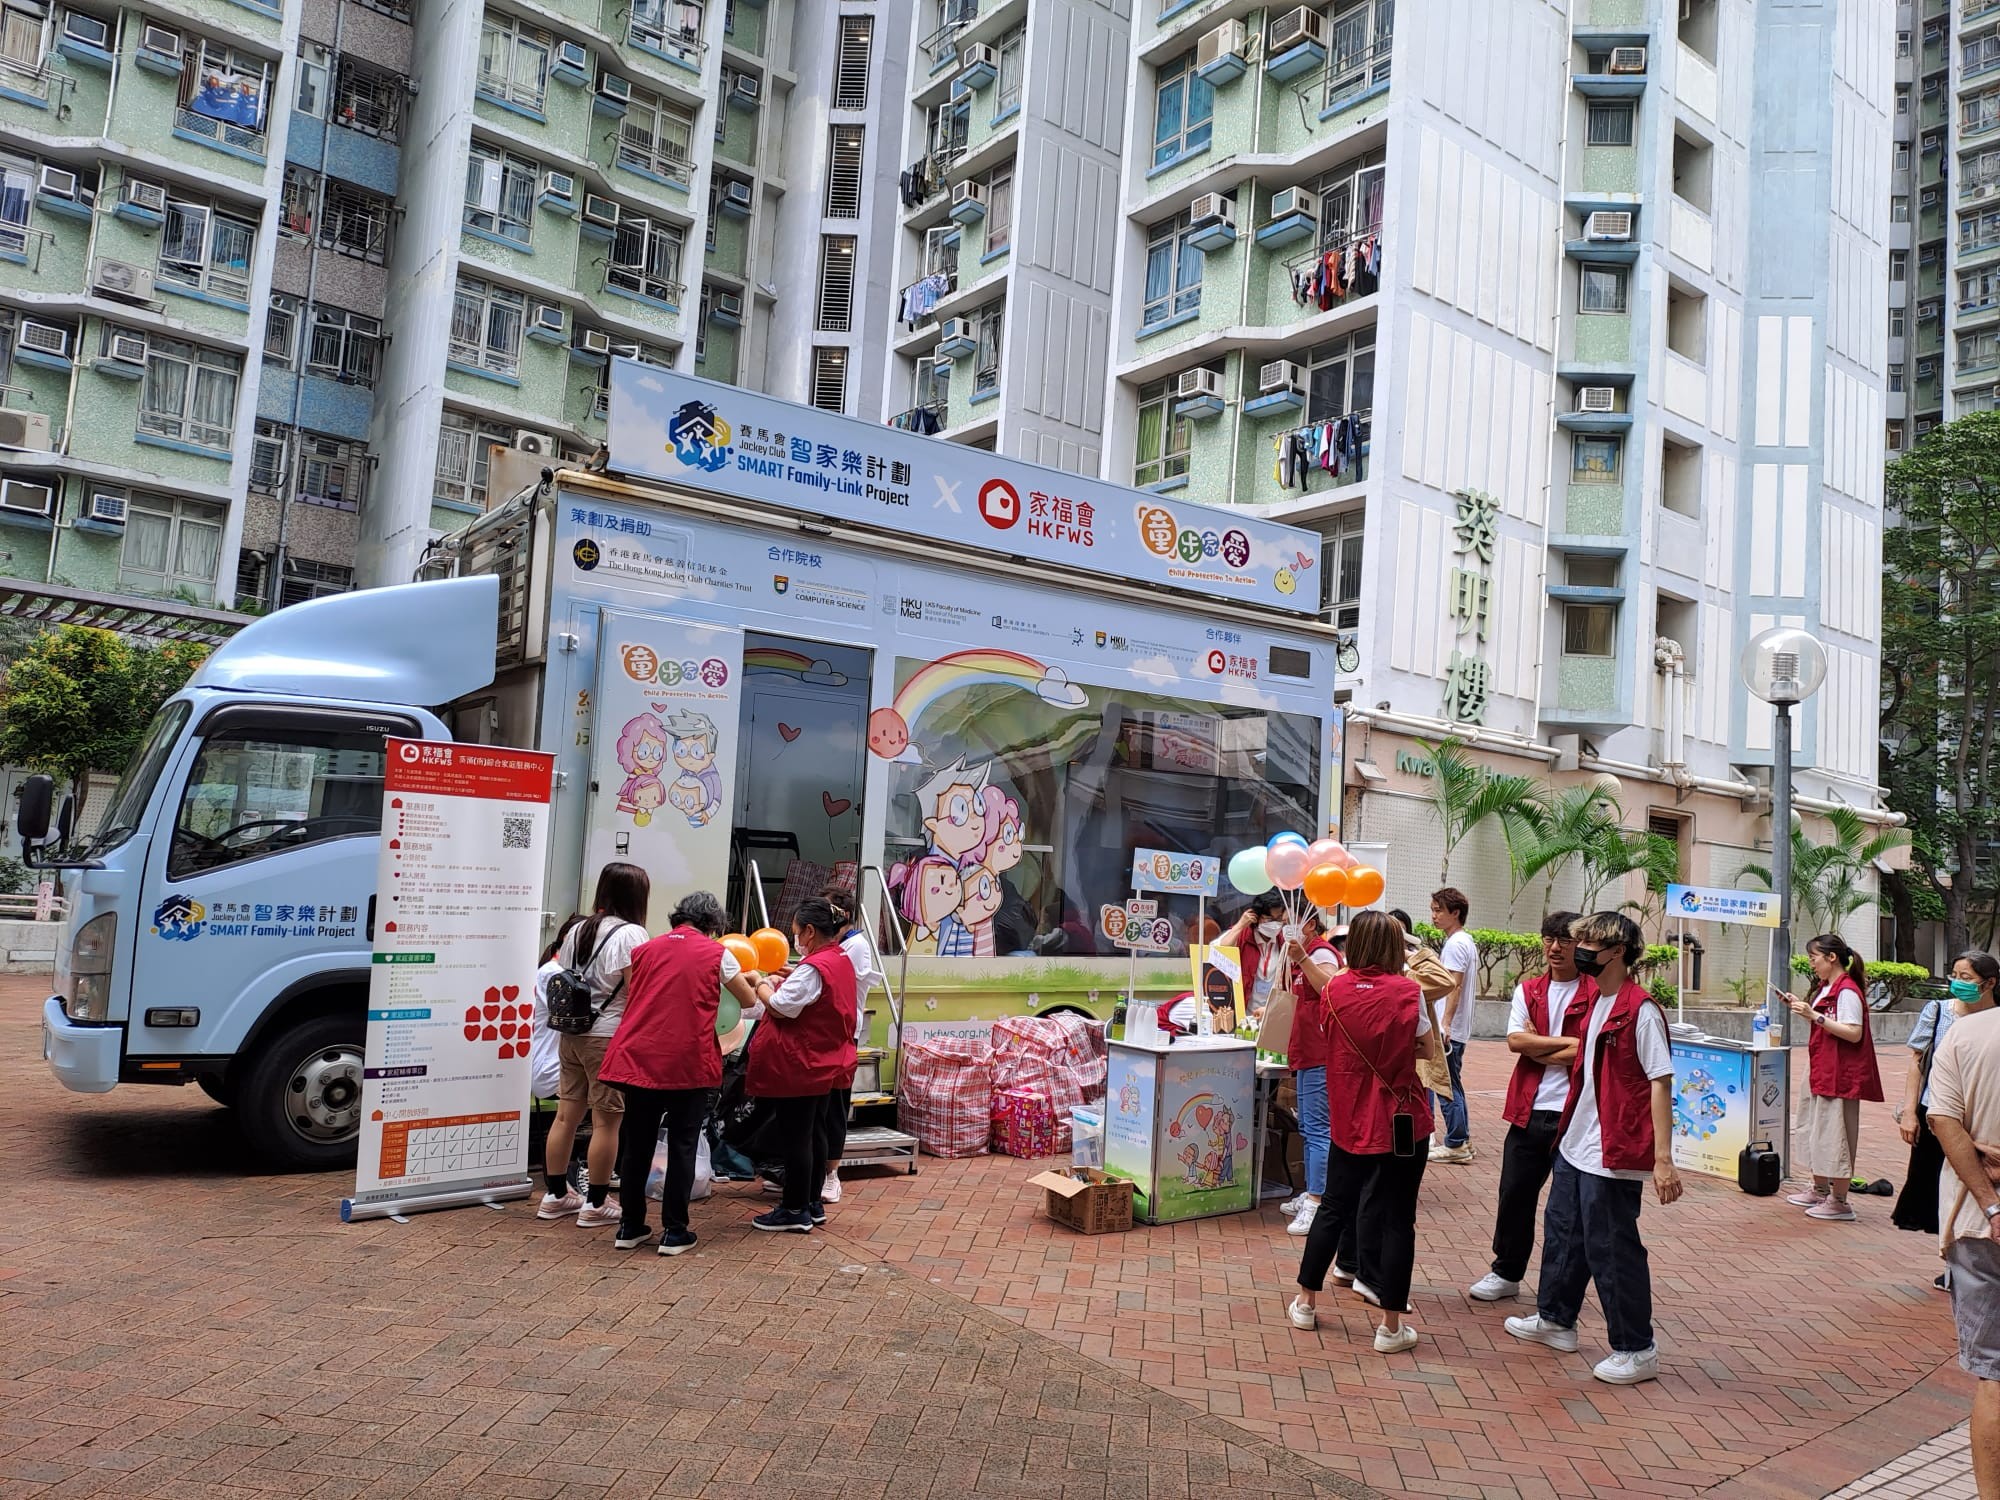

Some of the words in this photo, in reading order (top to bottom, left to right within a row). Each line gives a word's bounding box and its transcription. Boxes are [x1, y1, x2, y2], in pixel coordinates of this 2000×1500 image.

[739, 424, 786, 447] 賽馬會
[738, 438, 767, 457] Jockey
[768, 445, 786, 459] Club
[790, 436, 911, 487] 智家樂計劃
[737, 455, 784, 481] SMART
[787, 465, 863, 497] Family-Link
[866, 484, 910, 507] Project
[1029, 490, 1096, 528] 家福會
[571, 508, 651, 536] 策劃及捐助
[1027, 519, 1094, 547] HKFWS
[768, 546, 822, 568] 合作院校
[608, 561, 621, 570] The
[623, 563, 642, 575] Hong
[644, 567, 662, 578] Kong
[663, 570, 686, 582] Jockey
[687, 575, 703, 584] Club
[705, 577, 733, 588] Charities
[736, 582, 752, 592] Trust
[1168, 569, 1185, 577] Child
[795, 593, 835, 606] COMPUTER
[836, 600, 866, 611] SCIENCE
[901, 597, 922, 610] HKU
[1444, 487, 1500, 726] 葵明樓
[900, 607, 921, 620] Med
[1110, 635, 1126, 645] HKU
[1206, 628, 1241, 644] 合作夥伴
[1228, 655, 1257, 670] 家福會
[1228, 668, 1257, 679] HKFWS
[422, 746, 453, 758] 家福會
[422, 757, 452, 766] HKFWS
[212, 903, 250, 912] 賽馬會
[255, 904, 357, 923] 智家樂計劃
[212, 913, 234, 922] Jockey
[236, 914, 250, 922] Club
[210, 926, 249, 936] SMART
[251, 925, 315, 938] Family-Link
[318, 926, 355, 938] Project
[923, 1028, 991, 1040] hkfws.org.hk
